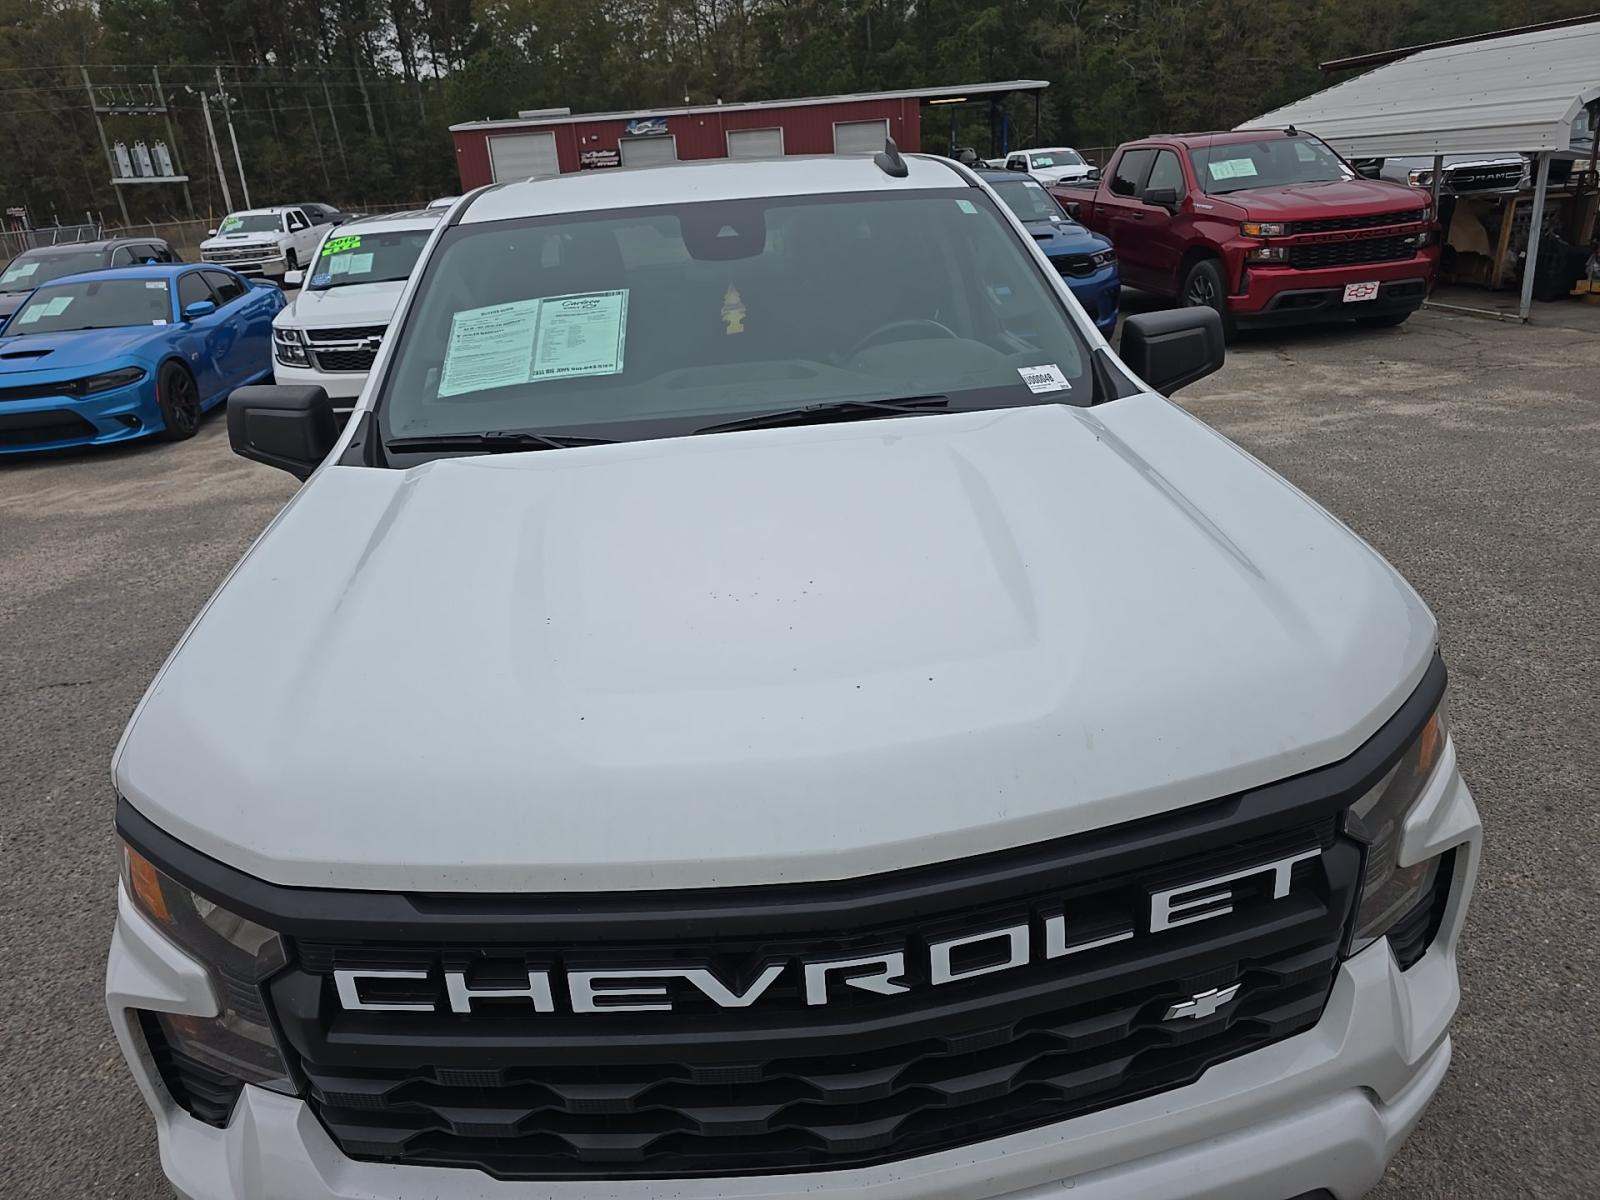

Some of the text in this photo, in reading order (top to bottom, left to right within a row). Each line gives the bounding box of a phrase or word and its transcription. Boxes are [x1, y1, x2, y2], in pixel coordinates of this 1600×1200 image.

[1476, 173, 1505, 181] RAM
[1295, 224, 1429, 244] CHEVROLET
[333, 847, 1322, 1014] CHEVROLET
